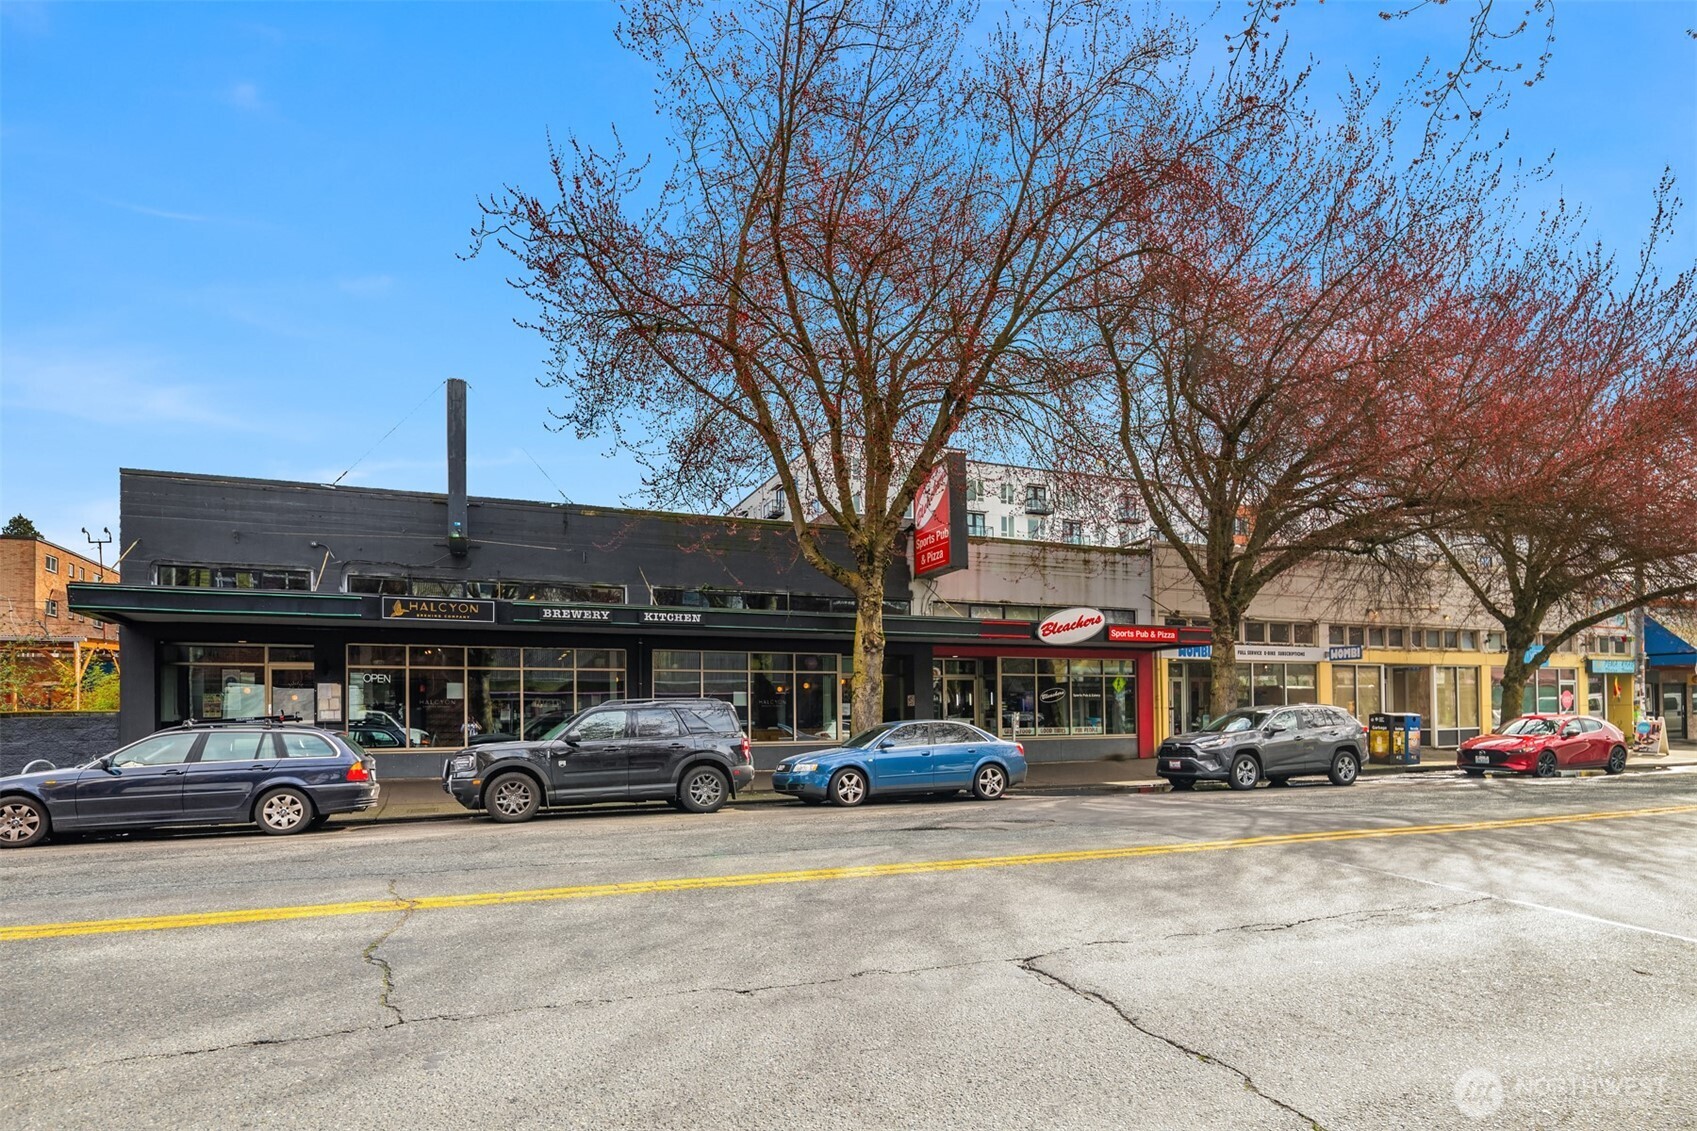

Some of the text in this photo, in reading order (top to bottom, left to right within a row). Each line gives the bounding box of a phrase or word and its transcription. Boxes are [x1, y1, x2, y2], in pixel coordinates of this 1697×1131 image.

[916, 527, 949, 551] Sports Pub
[921, 549, 944, 565] & Pizza
[409, 601, 479, 613] HALCYON
[542, 608, 702, 622] BREWERY KITCHEN
[1040, 614, 1103, 637] Bleachers
[1110, 629, 1176, 639] Sports Pub & Pizza
[363, 673, 391, 684] OPEN
